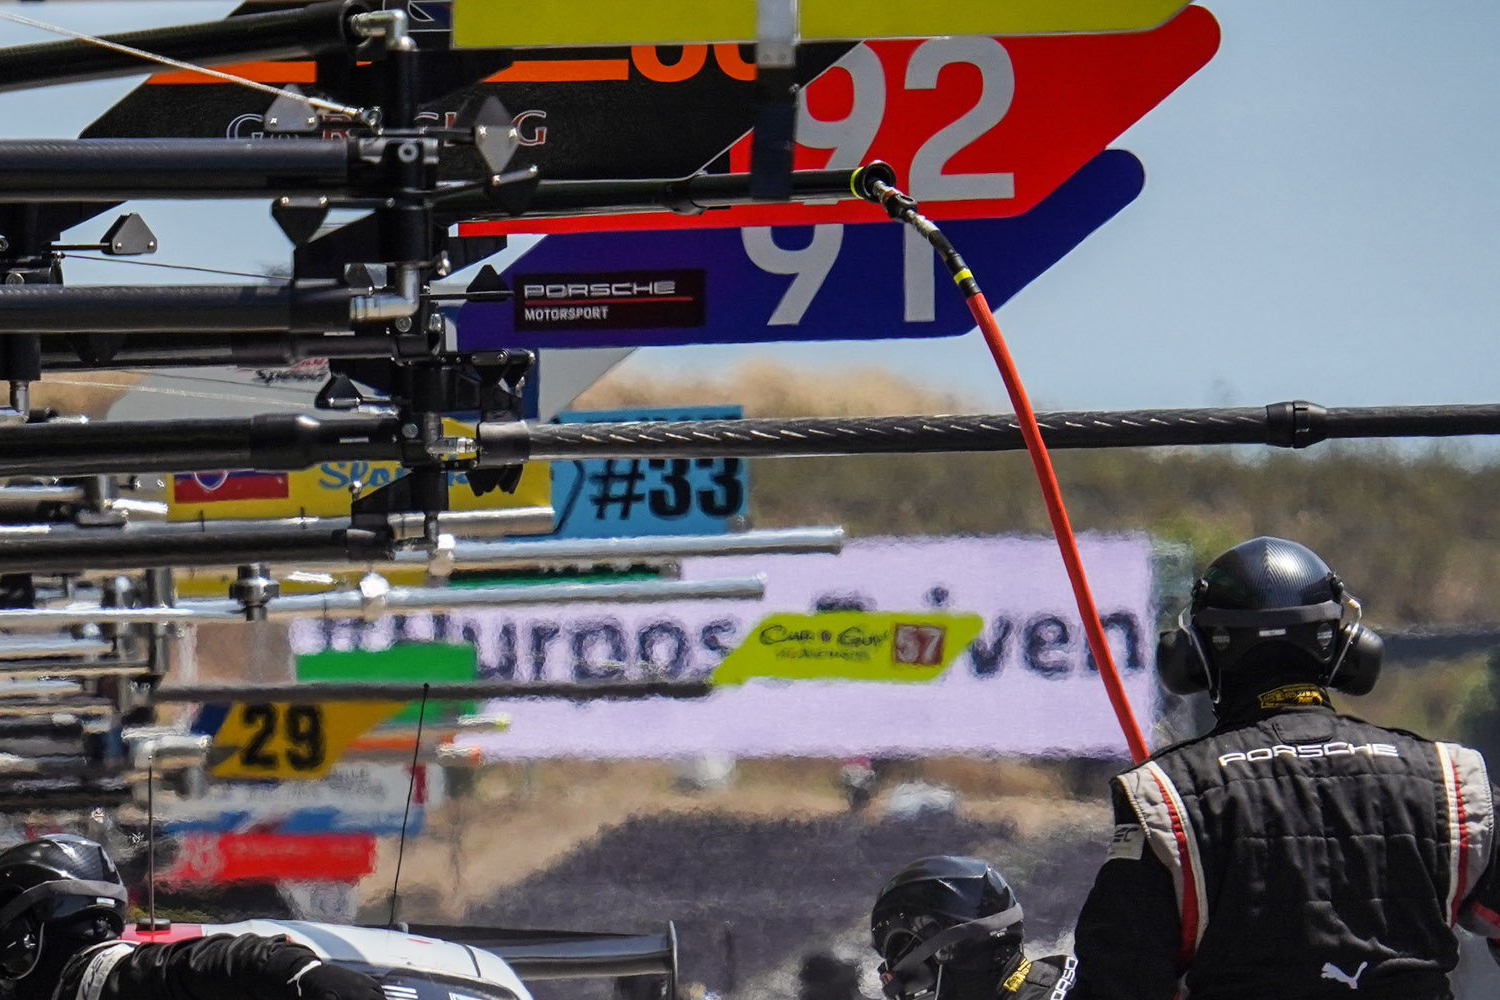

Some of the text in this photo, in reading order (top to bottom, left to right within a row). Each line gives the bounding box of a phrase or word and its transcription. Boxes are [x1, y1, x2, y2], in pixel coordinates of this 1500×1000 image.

[803, 36, 1015, 204] 92
[524, 280, 676, 298] PORSCHE
[741, 224, 935, 326] 91
[524, 305, 609, 323] MOTORSPORT
[589, 458, 744, 520] #33
[239, 702, 325, 771] 29
[1218, 742, 1400, 767] PORSCHE
